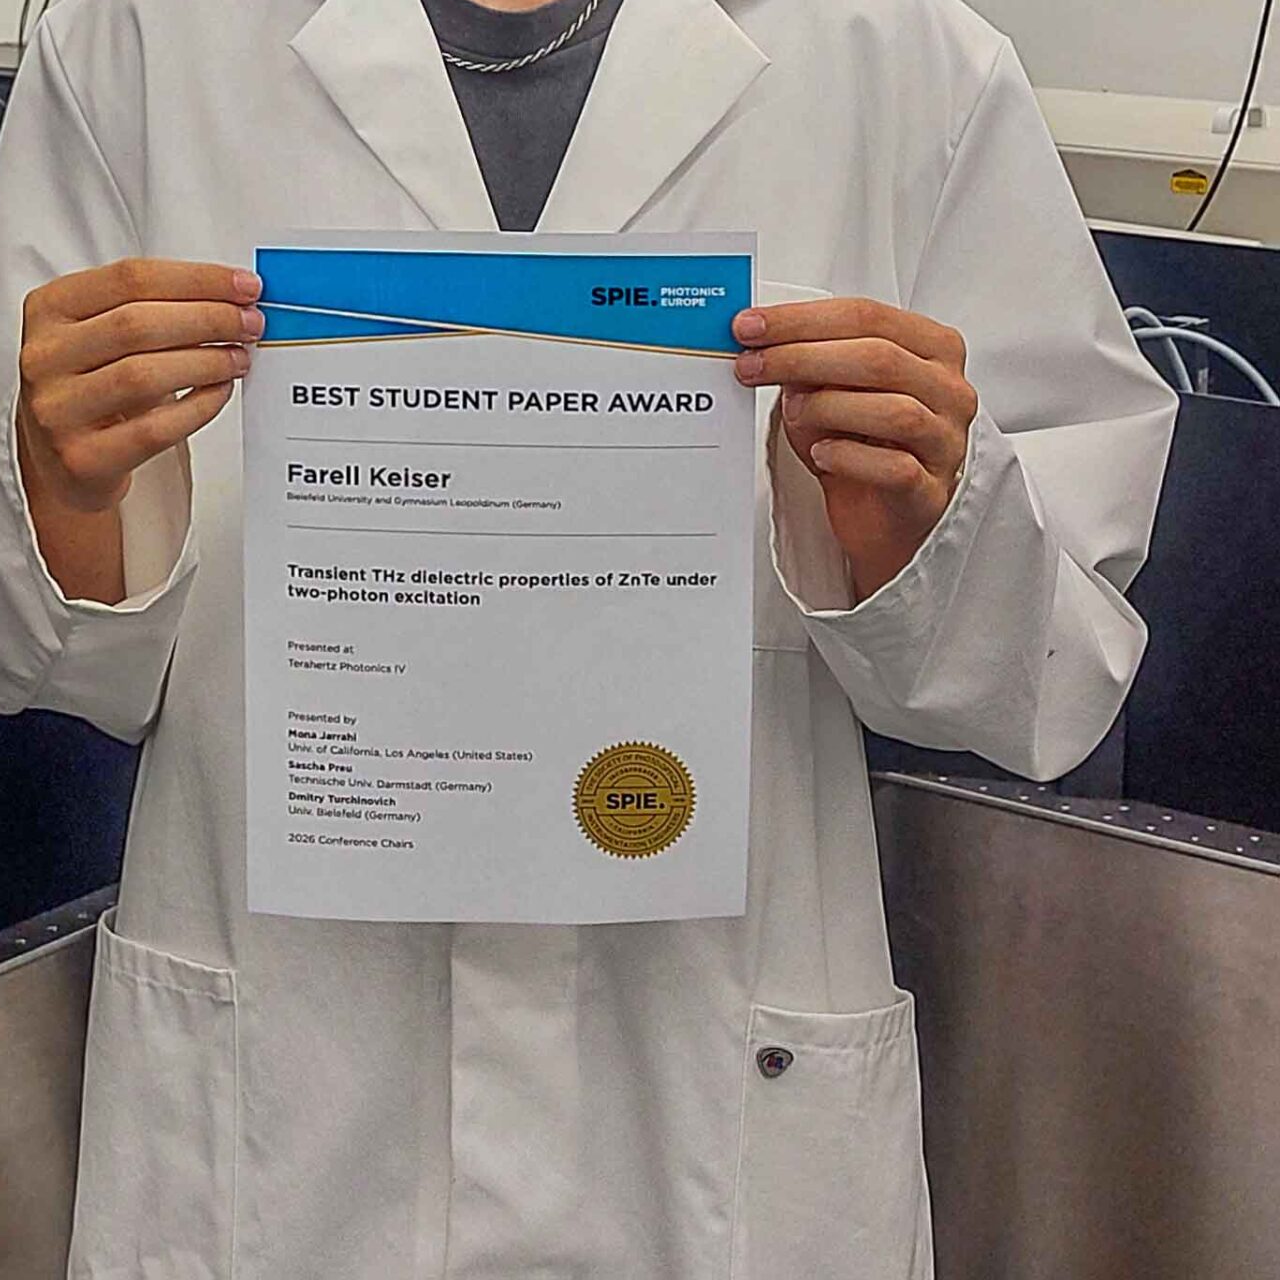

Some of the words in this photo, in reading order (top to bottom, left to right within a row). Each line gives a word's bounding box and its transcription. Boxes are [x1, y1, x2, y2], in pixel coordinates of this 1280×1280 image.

[591, 286, 658, 307] SPIE.
[660, 287, 726, 297] PHOTONICS
[660, 298, 707, 308] EUROPE
[292, 385, 361, 407] BEST
[369, 387, 498, 410] STUDENT
[508, 391, 599, 412] PAPER
[608, 393, 714, 412] AWARD
[288, 464, 360, 486] Farell
[370, 467, 452, 488] Keiser
[287, 491, 326, 502] Bielefeld
[327, 494, 373, 505] University
[375, 496, 393, 505] and
[394, 496, 448, 506] Gymnasium
[450, 498, 510, 508] Leopoldinum
[512, 500, 562, 510] (Germany)
[287, 564, 367, 581] Transient
[371, 568, 406, 583] THz
[411, 570, 494, 586] dielectric
[499, 572, 590, 589] properties
[595, 572, 614, 587] of
[618, 573, 661, 587] ZnTe
[666, 572, 718, 587] under
[287, 584, 389, 603] two-photon
[394, 590, 481, 606] excitation
[288, 640, 341, 654] Presented
[343, 645, 355, 655] at
[288, 658, 338, 671] Terahertz
[340, 662, 392, 673] Photonics
[394, 664, 406, 674] IV
[288, 711, 341, 724] Presented
[343, 715, 357, 726] by
[288, 729, 317, 739] Mona
[320, 731, 357, 742] Jarrahi
[288, 742, 313, 753] Univ.
[316, 745, 328, 754] of
[330, 745, 383, 758] California,
[385, 748, 404, 758] Los
[407, 749, 449, 760] Angeles
[452, 750, 493, 761] (United
[495, 751, 533, 762] States)
[288, 760, 326, 771] Sascha
[328, 763, 353, 773] Preu
[288, 774, 346, 787] Technische
[348, 778, 375, 788] Univ.
[377, 779, 433, 791] Darmstadt
[435, 781, 493, 793] (Germany)
[288, 792, 325, 804] Dmitry
[328, 794, 397, 806] Turchinovich
[606, 793, 666, 810] SPIE.
[288, 805, 314, 816] Univ.
[317, 807, 362, 819] Bielefeld
[364, 810, 422, 822] (Germany)
[288, 833, 316, 843] 2026
[318, 835, 378, 848] Conference
[381, 838, 414, 849] Chairs
